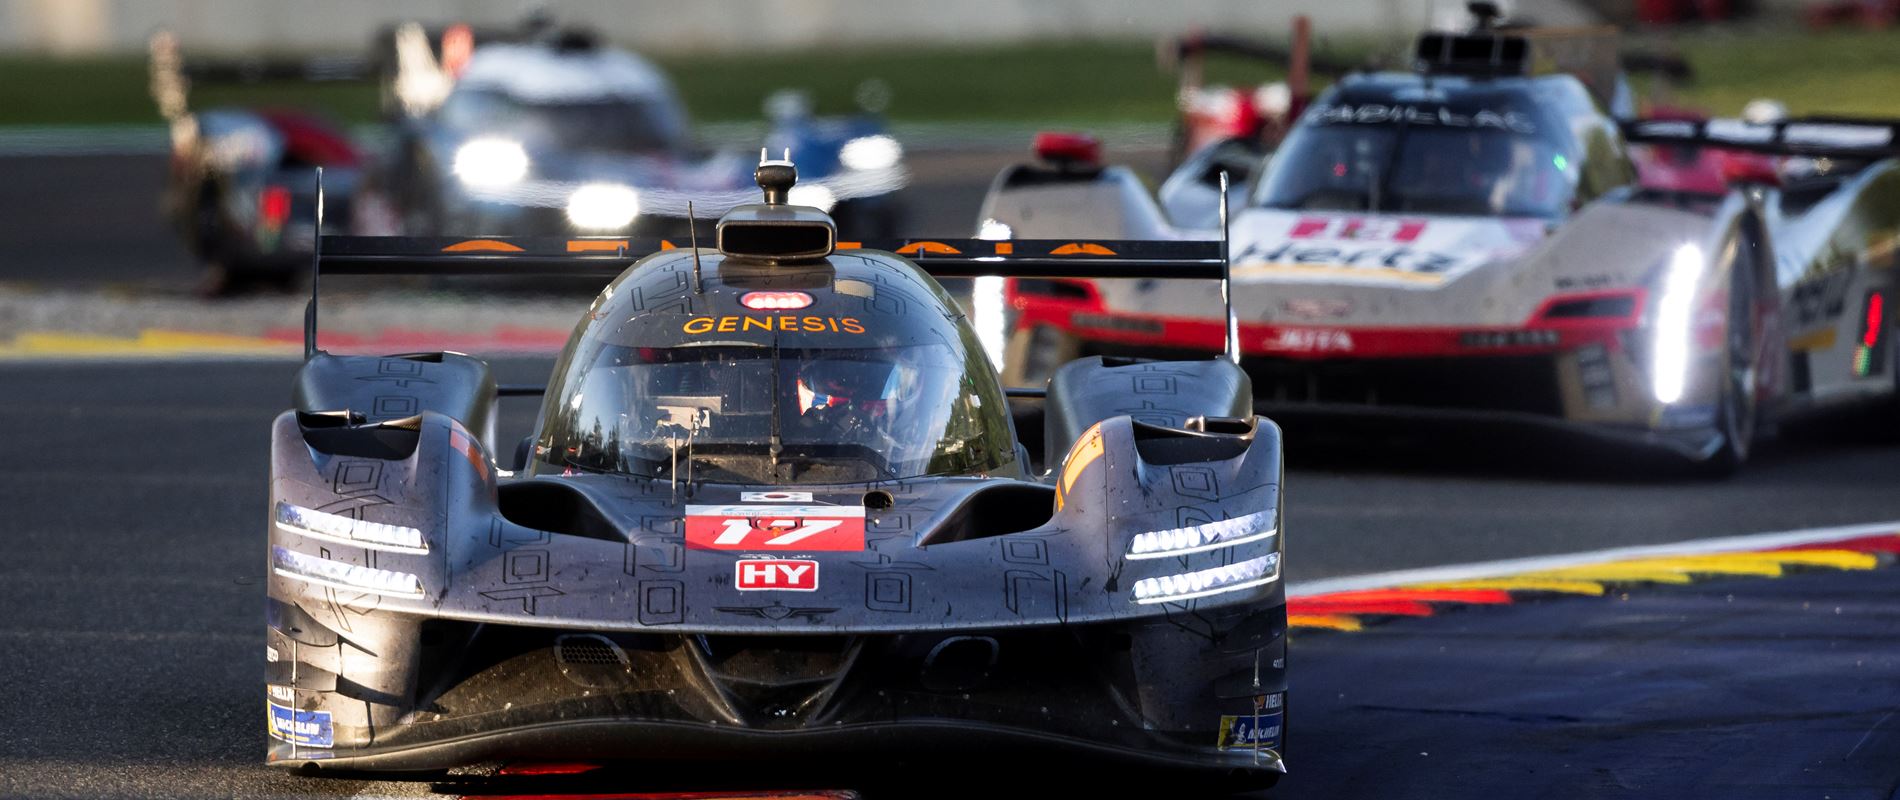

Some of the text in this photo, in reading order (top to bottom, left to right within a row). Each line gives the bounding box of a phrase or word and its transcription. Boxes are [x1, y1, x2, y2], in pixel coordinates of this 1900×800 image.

[682, 315, 866, 334] GENESIS
[713, 519, 844, 545] 17
[744, 565, 811, 584] HY
